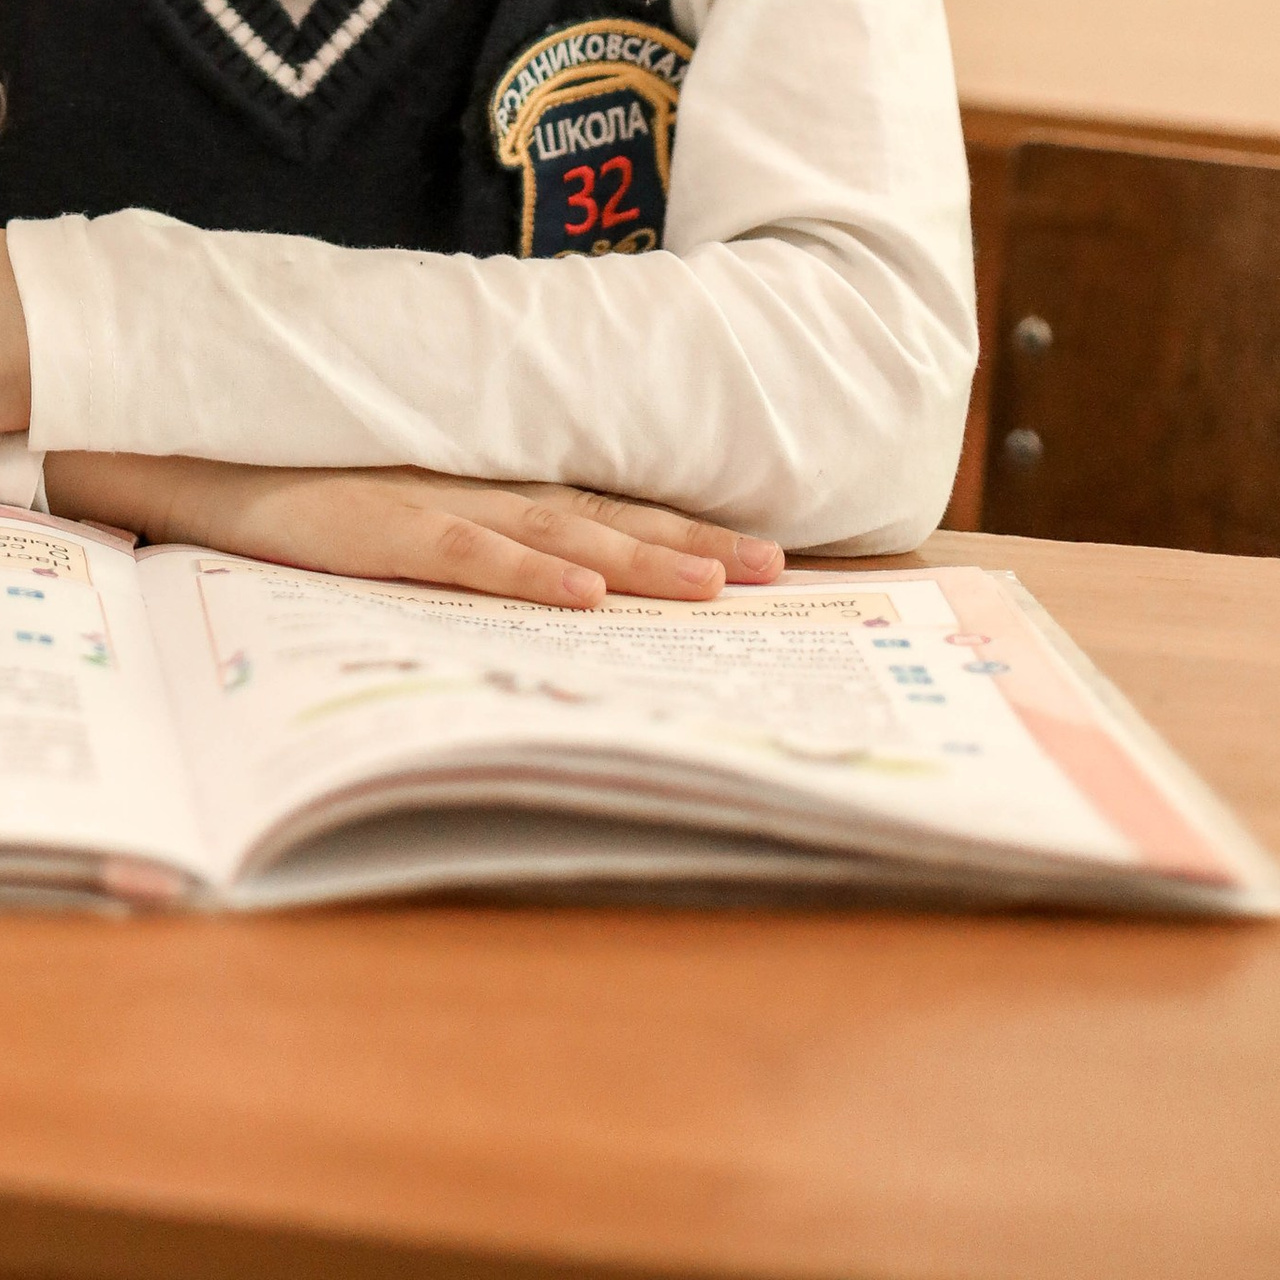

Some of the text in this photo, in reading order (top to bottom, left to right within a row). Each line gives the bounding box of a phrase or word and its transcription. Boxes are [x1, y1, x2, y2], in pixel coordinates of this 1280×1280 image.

[534, 101, 649, 160] ШКОЛА
[562, 155, 641, 236] 32
[48, 550, 71, 561] О
[763, 599, 857, 609] дится.
[691, 609, 811, 618] людьми
[840, 609, 862, 618] С
